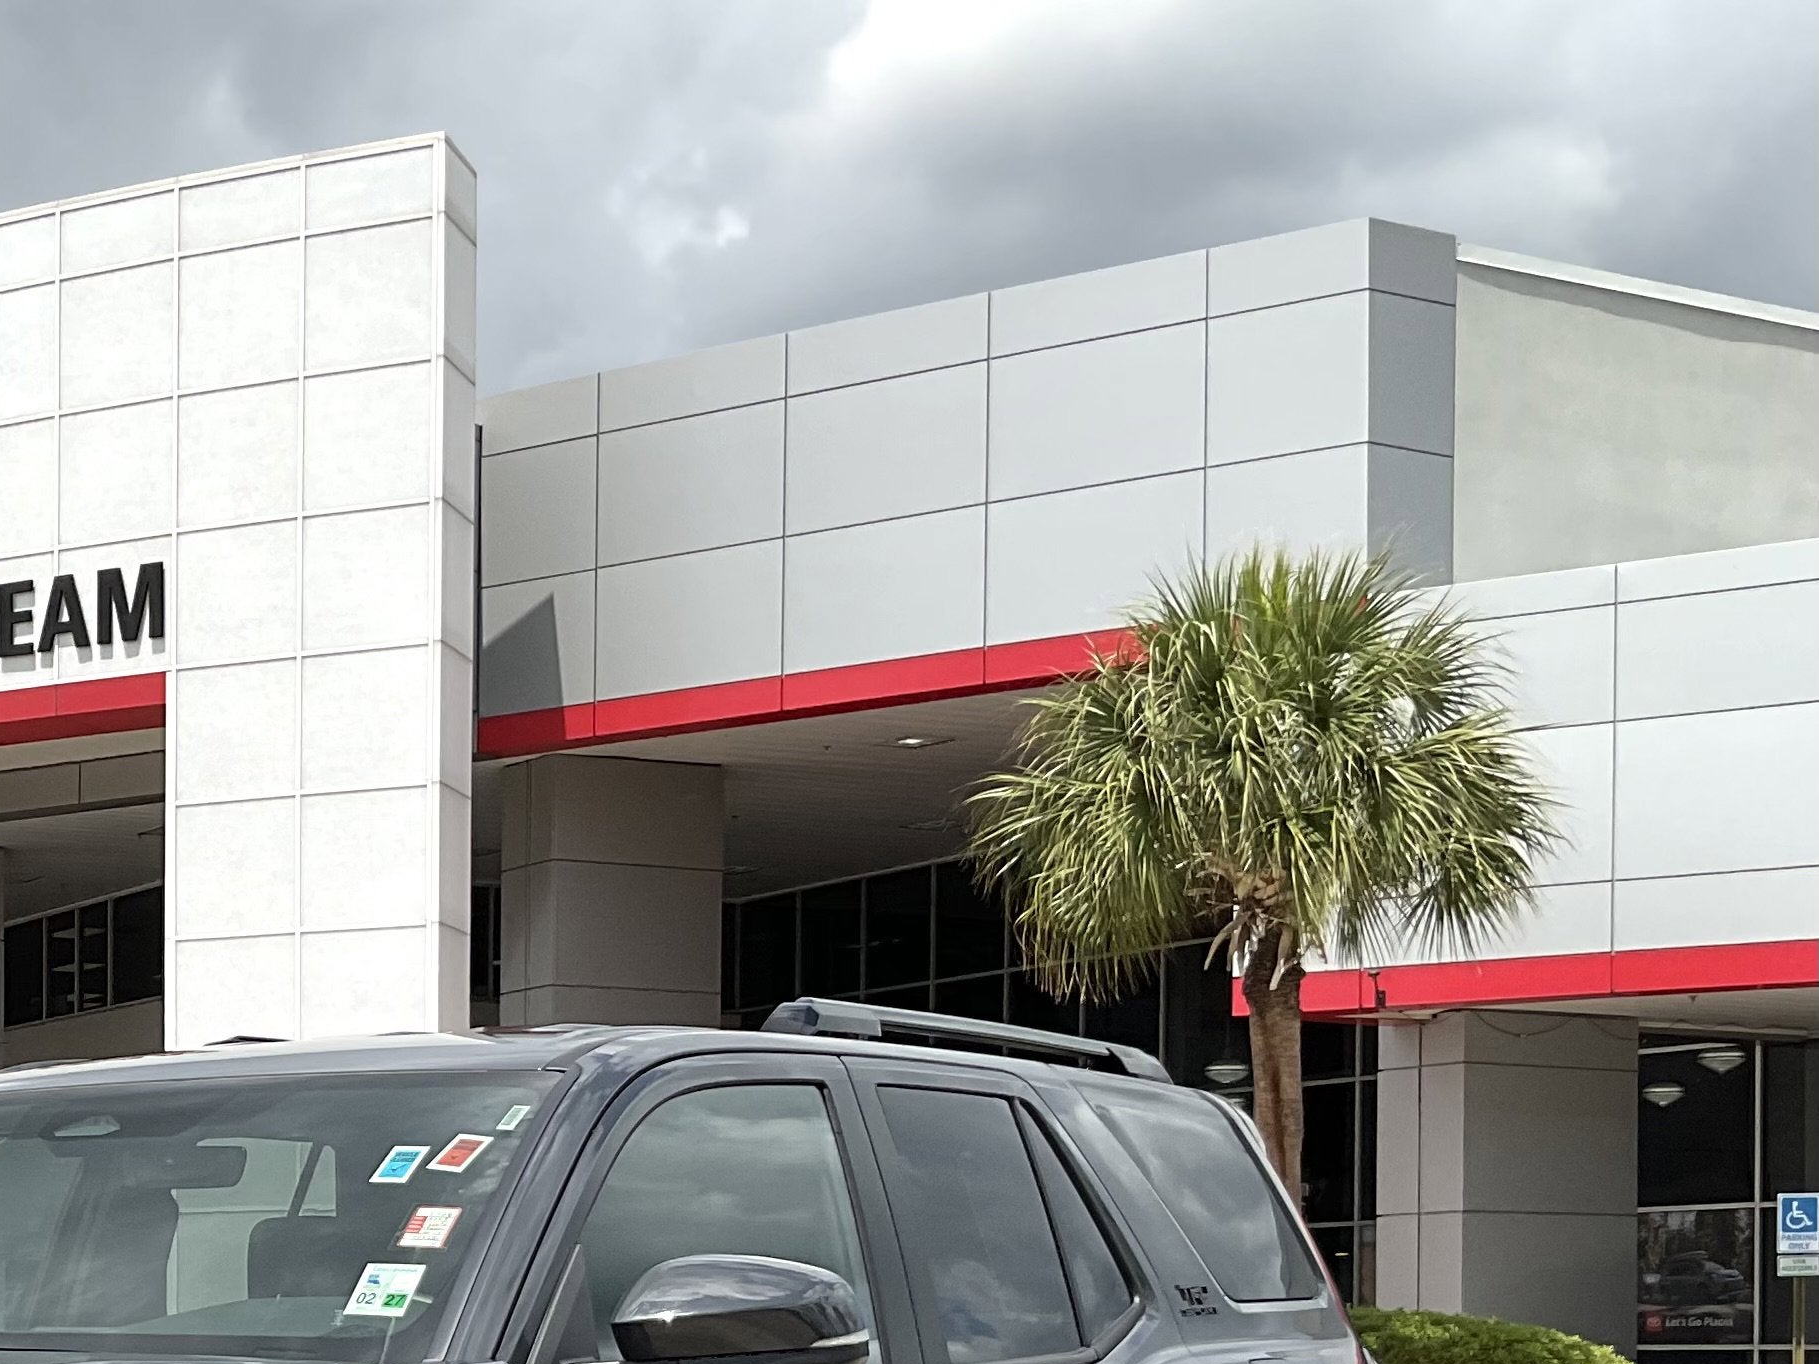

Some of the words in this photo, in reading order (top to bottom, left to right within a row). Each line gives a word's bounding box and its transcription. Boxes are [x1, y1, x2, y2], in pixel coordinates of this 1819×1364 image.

[356, 1292, 377, 1304] 02
[384, 1294, 409, 1306] 27
[1688, 1316, 1703, 1327] Go
